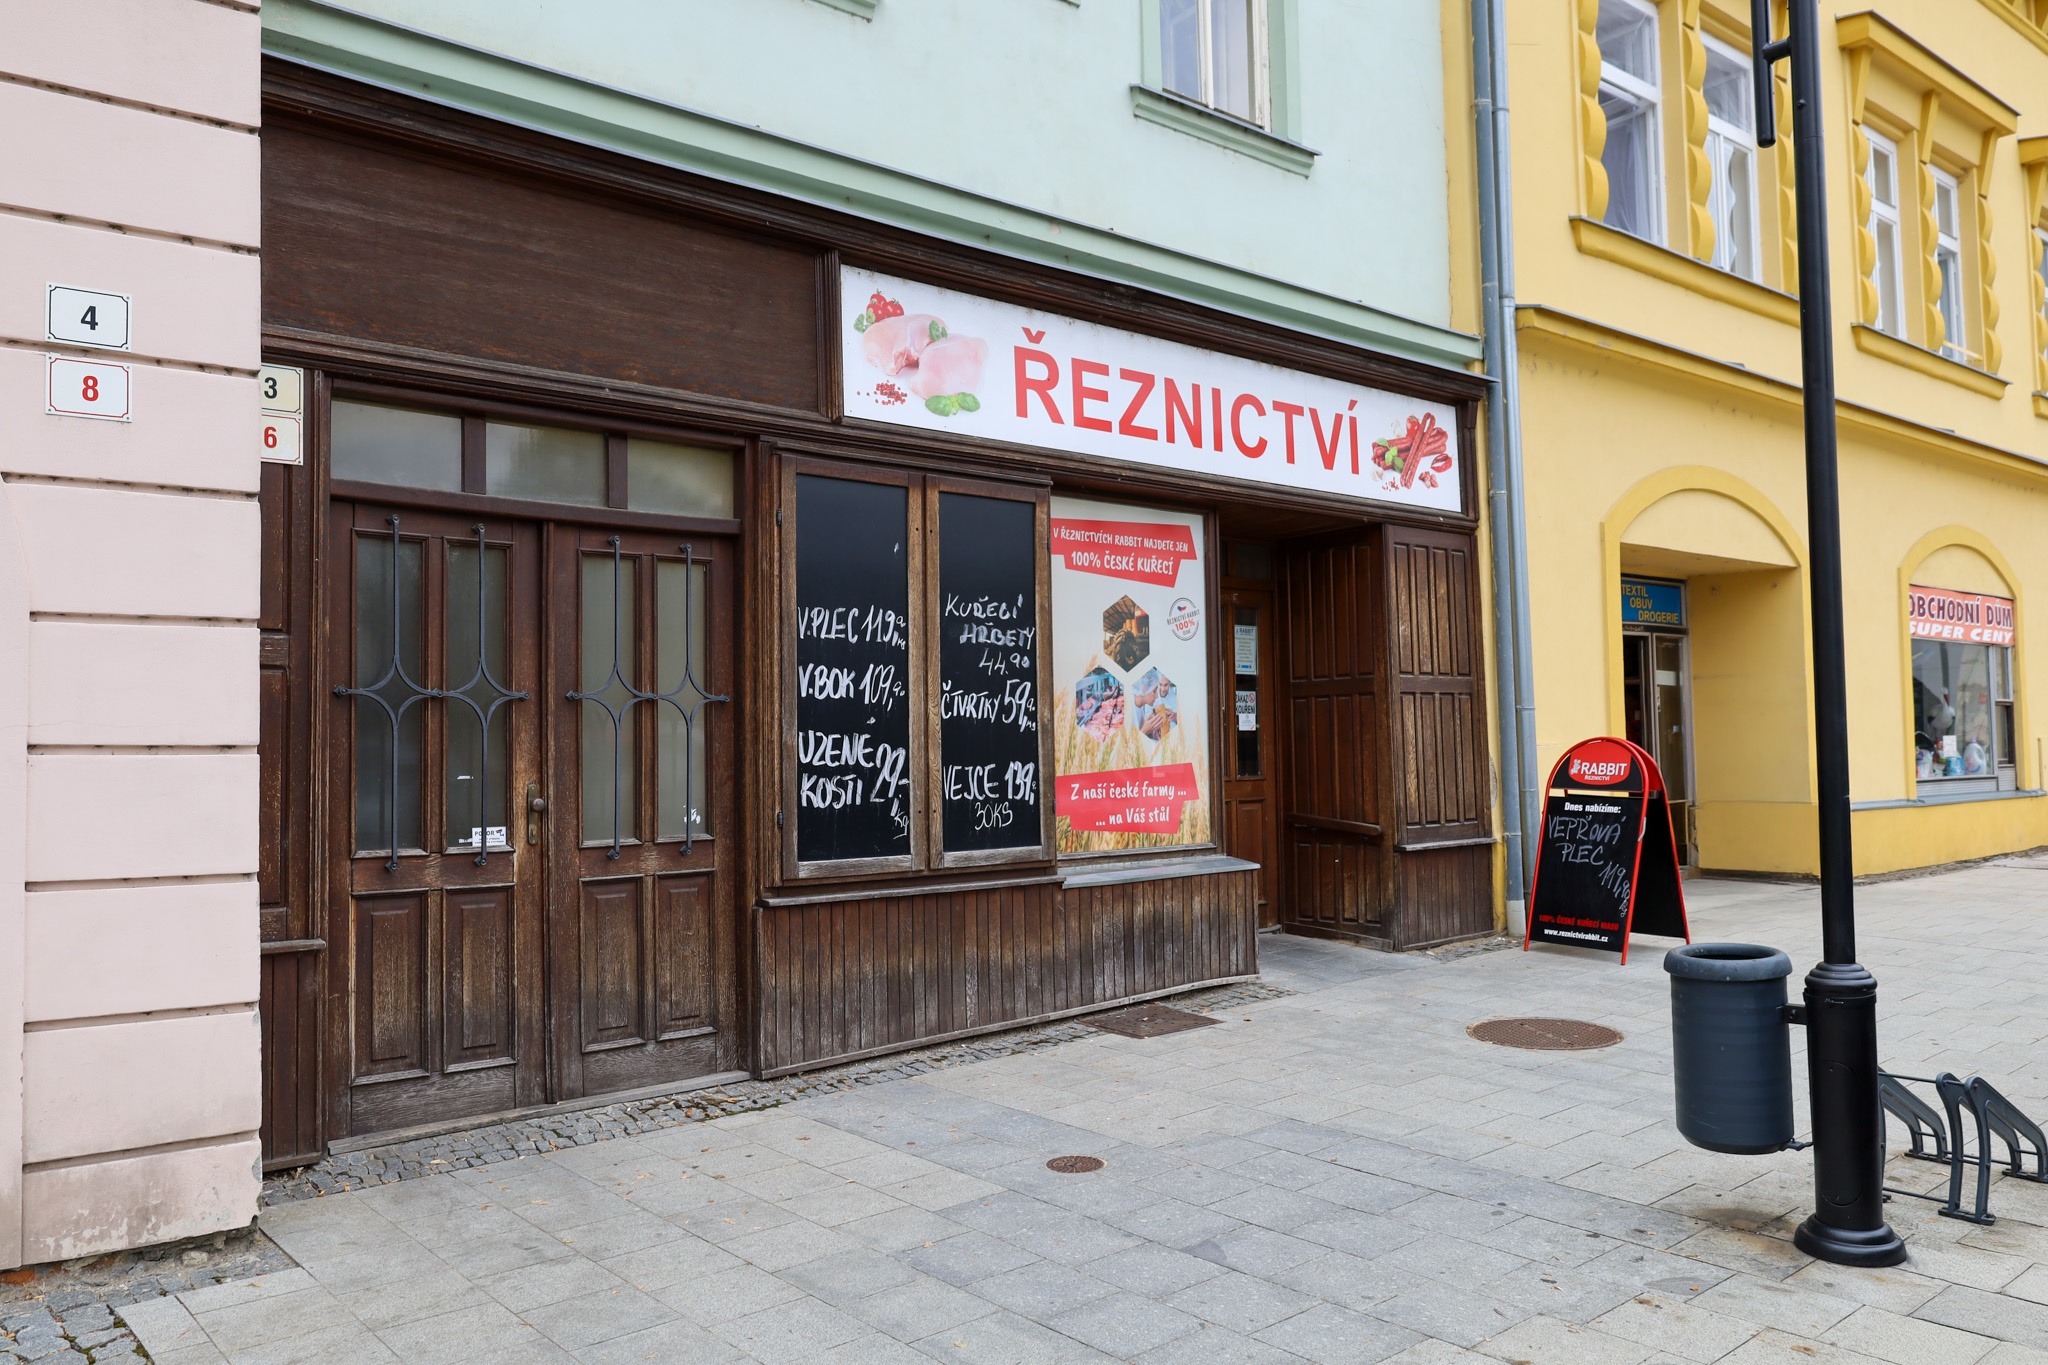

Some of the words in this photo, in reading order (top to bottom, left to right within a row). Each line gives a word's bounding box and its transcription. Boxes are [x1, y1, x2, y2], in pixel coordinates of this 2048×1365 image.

[81, 305, 98, 331] 4
[82, 375, 99, 402] 8
[264, 377, 278, 399] 3
[1013, 327, 1360, 475] ŘEZNICTVÍ
[264, 426, 277, 448] 6
[1053, 527, 1059, 538] V
[1061, 526, 1113, 544] ŘEZNICTVÍCH
[1114, 535, 1142, 548] RABBIT
[1143, 538, 1174, 551] NAJDETE
[1175, 541, 1188, 553] JEN
[1071, 551, 1101, 568] 100%
[1104, 551, 1135, 571] ČESKÉ
[1137, 555, 1173, 575] KUŘECÍ
[1621, 584, 1648, 597] TEXTIL
[1629, 597, 1652, 609] OBUV
[1909, 594, 1981, 625] OBCHODNÍ
[1986, 600, 2013, 629] DŮM
[1175, 618, 1195, 631] 100%
[1638, 610, 1679, 624] DROGERIE
[1909, 621, 1965, 639] SUPER
[1970, 628, 2013, 643] CENY
[799, 716, 875, 767] UZENÉ
[1580, 762, 1628, 777] RABBIT
[1584, 774, 1610, 782] ŘEZNICTVÍ
[943, 764, 999, 800] VEJCE
[1070, 783, 1080, 800] Z
[1082, 782, 1107, 800] naší
[1109, 781, 1139, 799] české
[1142, 780, 1175, 801] farmy
[1109, 813, 1123, 825] na
[1126, 807, 1146, 824] Váš
[1149, 805, 1170, 822] stůl
[1564, 802, 1583, 812] Dnes
[1585, 802, 1622, 813] nabízíme:
[1548, 814, 1627, 845] VEPŘOVÁ
[1555, 842, 1604, 866] PLEC
[1539, 914, 1555, 923] 100%
[1556, 914, 1576, 926] ČESKÉ
[1577, 918, 1600, 929] KUŘECÍ
[1601, 921, 1619, 931] MASO
[1543, 928, 1609, 943] www.reznictvirabbit.cz
